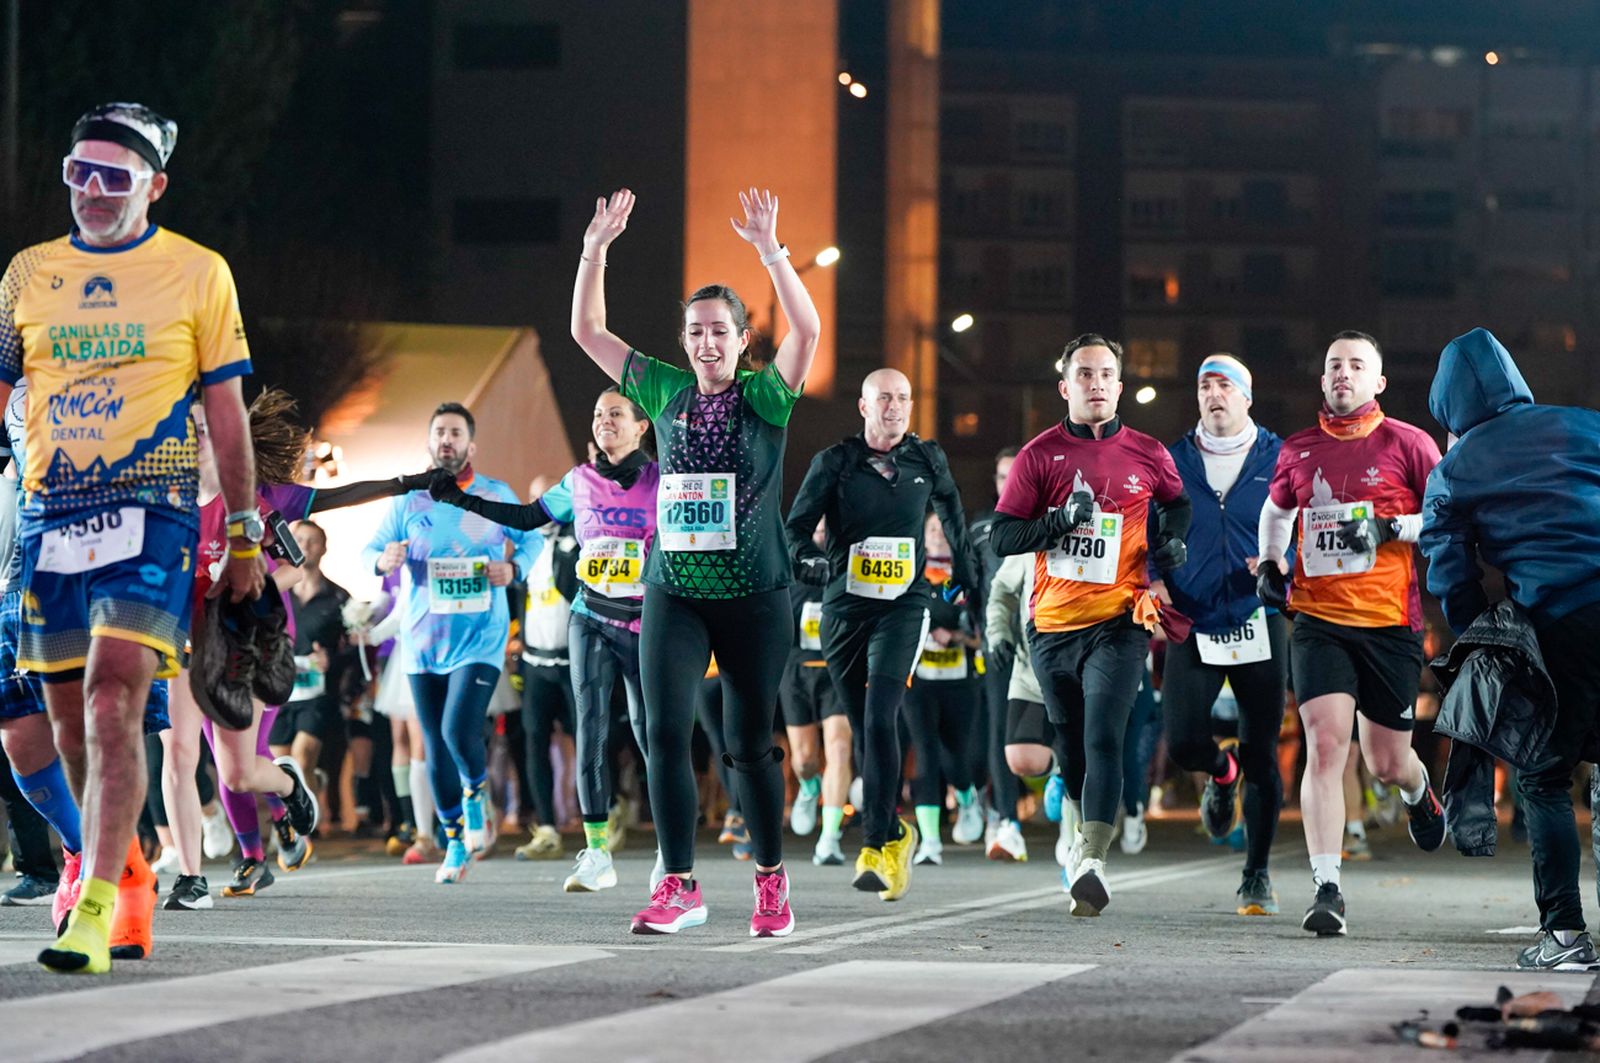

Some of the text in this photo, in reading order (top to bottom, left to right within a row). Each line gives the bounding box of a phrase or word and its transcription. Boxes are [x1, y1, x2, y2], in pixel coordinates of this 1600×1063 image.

[48, 322, 145, 341] CANILLAS DE
[52, 340, 145, 361] ALBAIDA
[51, 427, 105, 441] DENTAL
[667, 501, 724, 525] 12560
[1061, 535, 1106, 559] 4730
[588, 559, 630, 577] 6434
[861, 559, 903, 578] 6435
[438, 577, 482, 595] 13155
